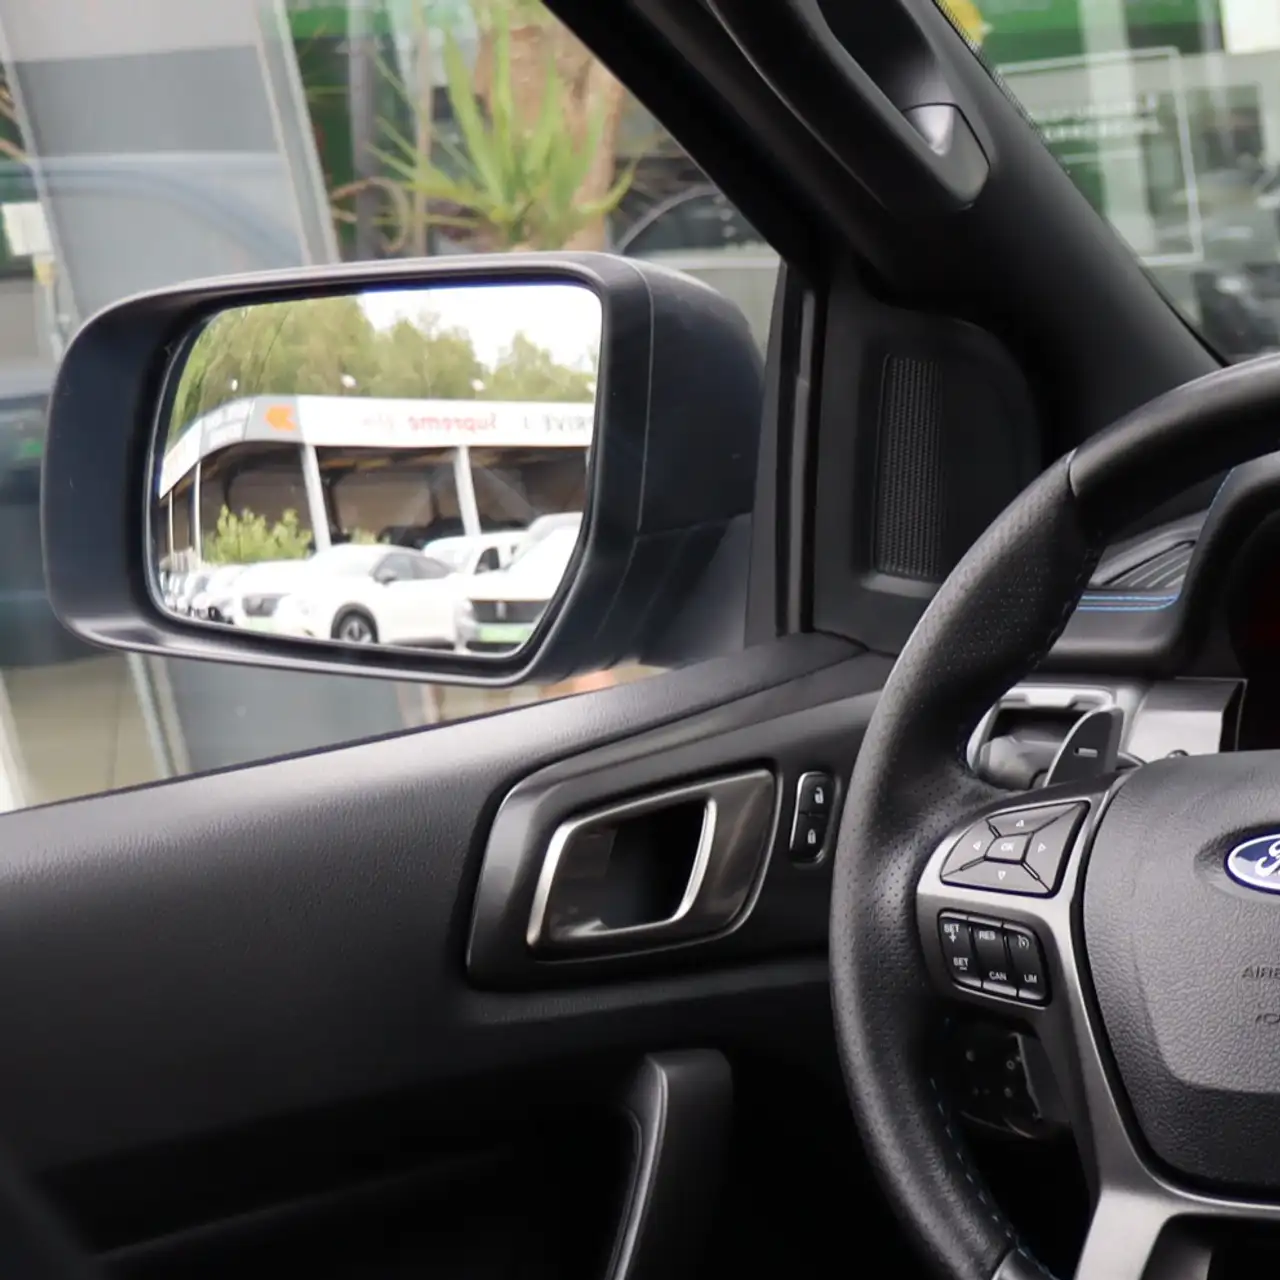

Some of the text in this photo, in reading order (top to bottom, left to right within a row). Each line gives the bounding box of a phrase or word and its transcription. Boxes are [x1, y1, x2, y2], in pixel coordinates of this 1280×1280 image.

[1000, 842, 1015, 853] OK
[943, 923, 961, 934] SET
[978, 929, 997, 941] RES
[952, 956, 969, 967] SET
[988, 970, 1008, 982] CAN
